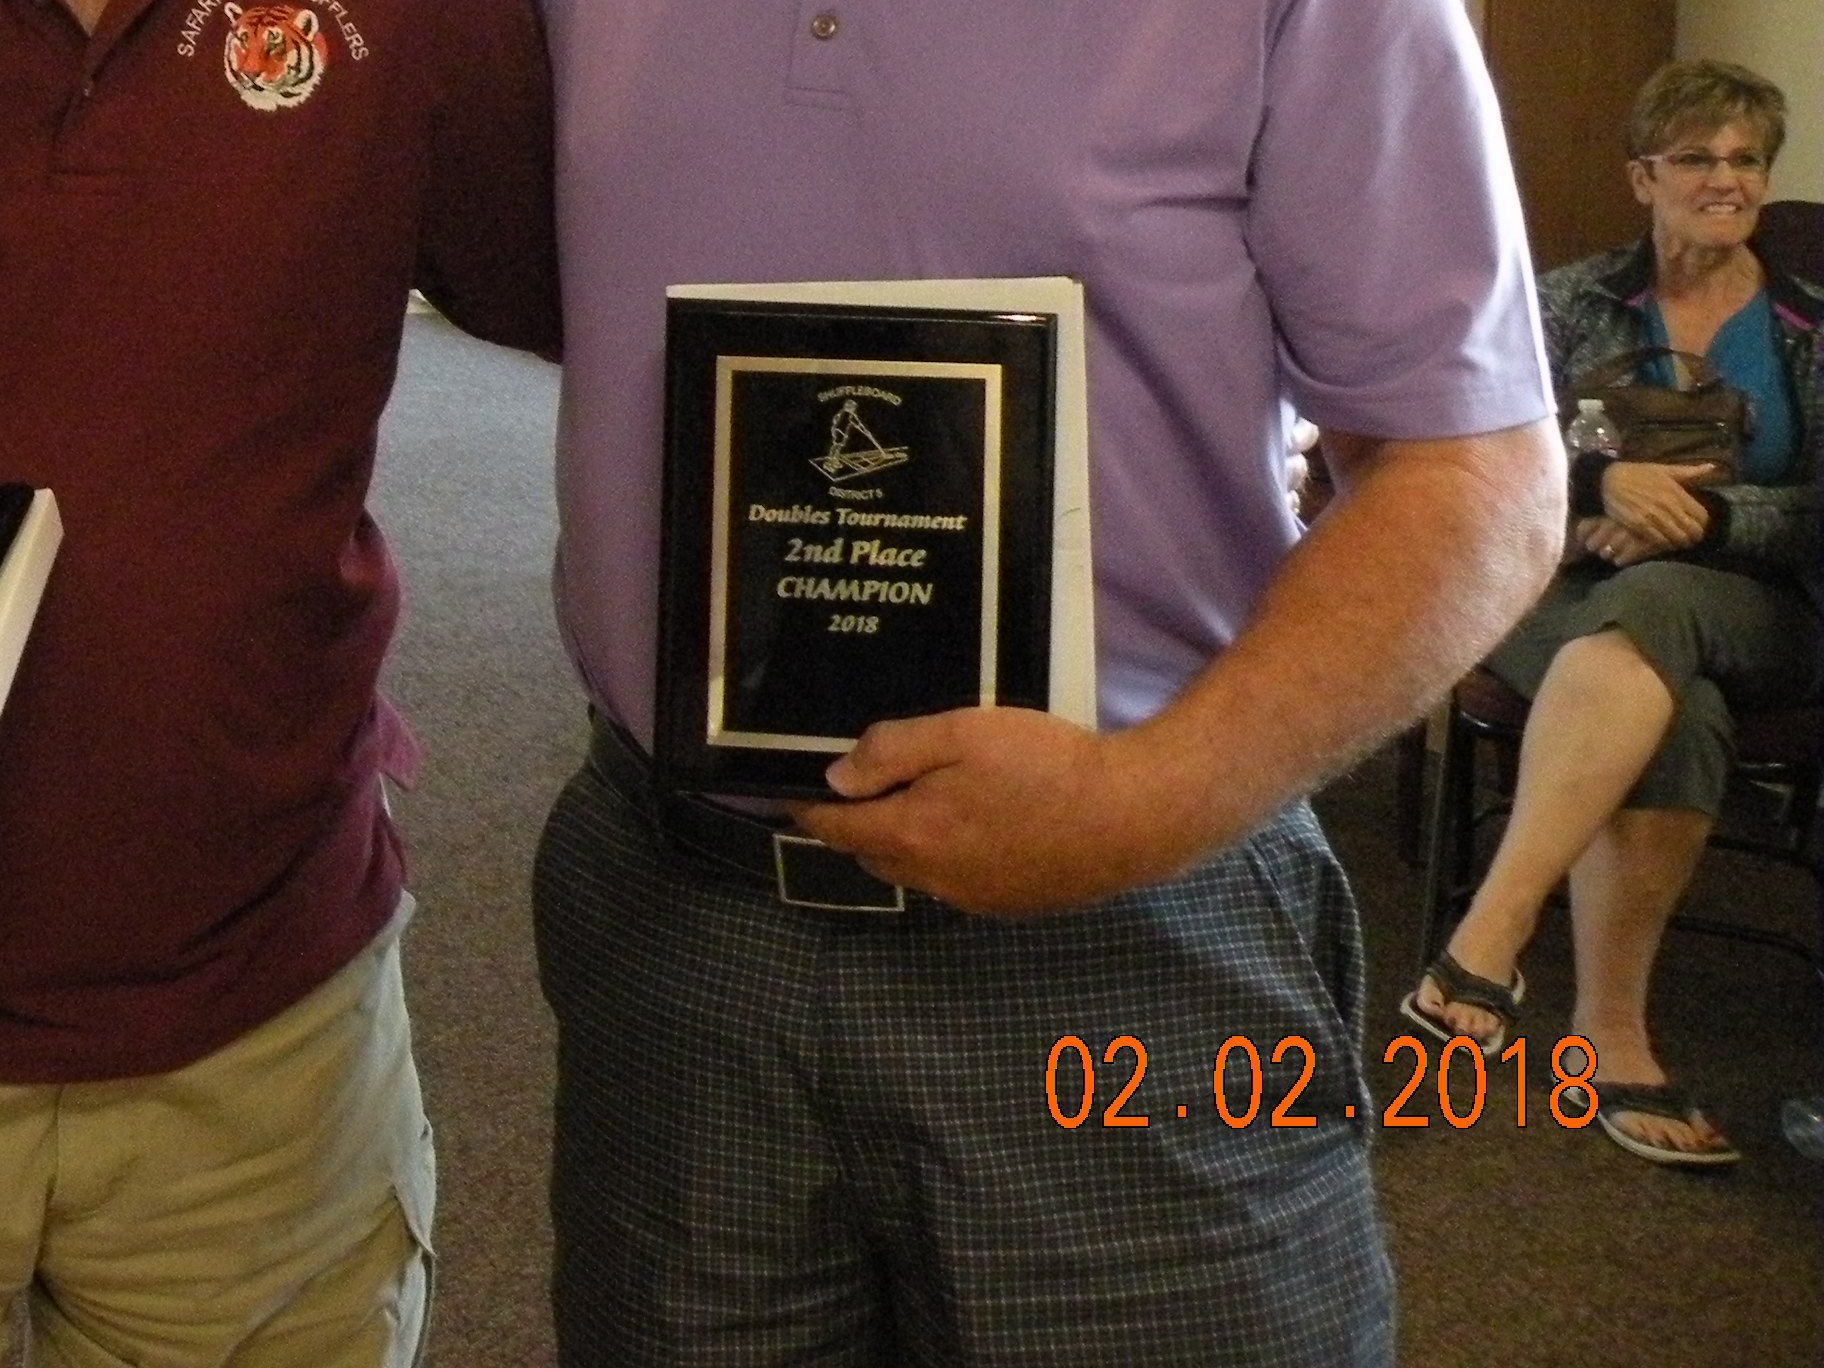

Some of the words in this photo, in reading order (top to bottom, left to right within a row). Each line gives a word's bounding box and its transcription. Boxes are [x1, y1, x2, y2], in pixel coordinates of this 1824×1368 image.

[817, 385, 902, 406] SHUFFLEBOARD
[829, 486, 873, 500] DISTRICT
[748, 503, 830, 524] Doubles
[836, 507, 968, 531] Tournament
[784, 537, 845, 564] 2nd
[849, 539, 927, 568] Place
[776, 576, 934, 605] CHAMPION
[828, 614, 880, 633] 2018
